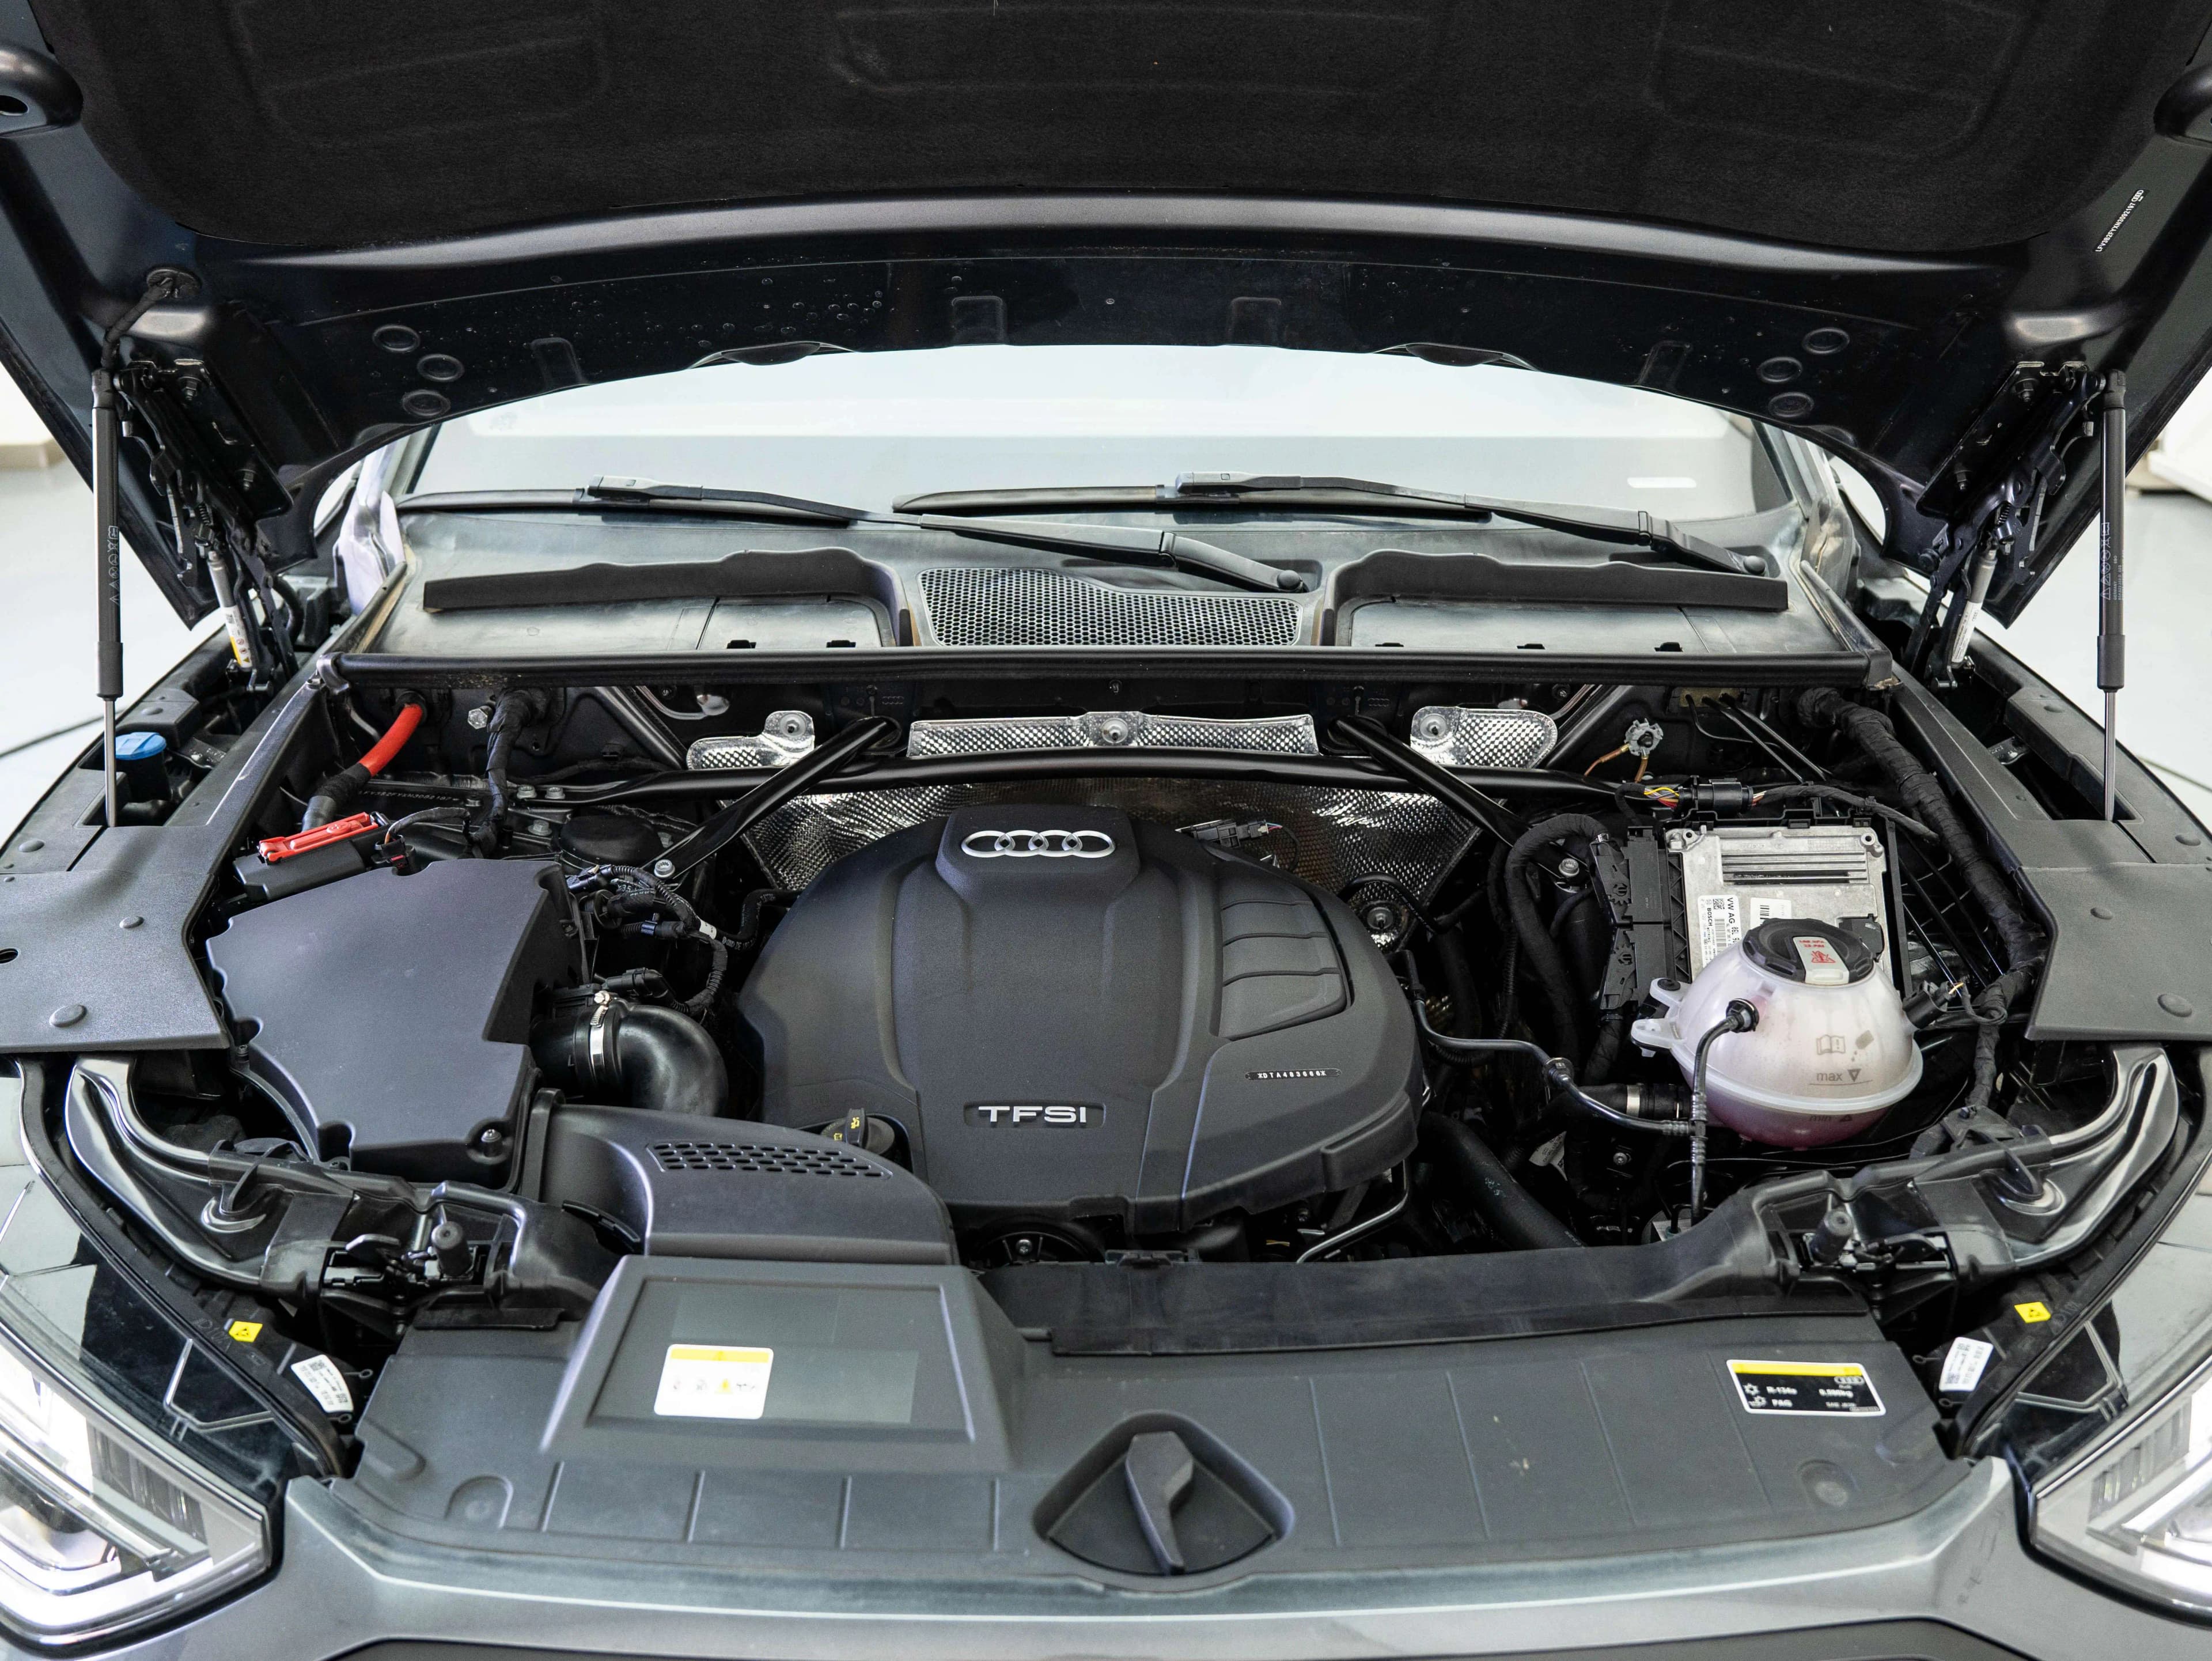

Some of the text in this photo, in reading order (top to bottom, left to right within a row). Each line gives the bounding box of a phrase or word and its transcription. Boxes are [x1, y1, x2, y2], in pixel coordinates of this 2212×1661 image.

[1727, 897, 1734, 910] VW
[1728, 913, 1736, 924] AG
[1816, 1072, 1843, 1081] max
[978, 1106, 1086, 1123] TFSI
